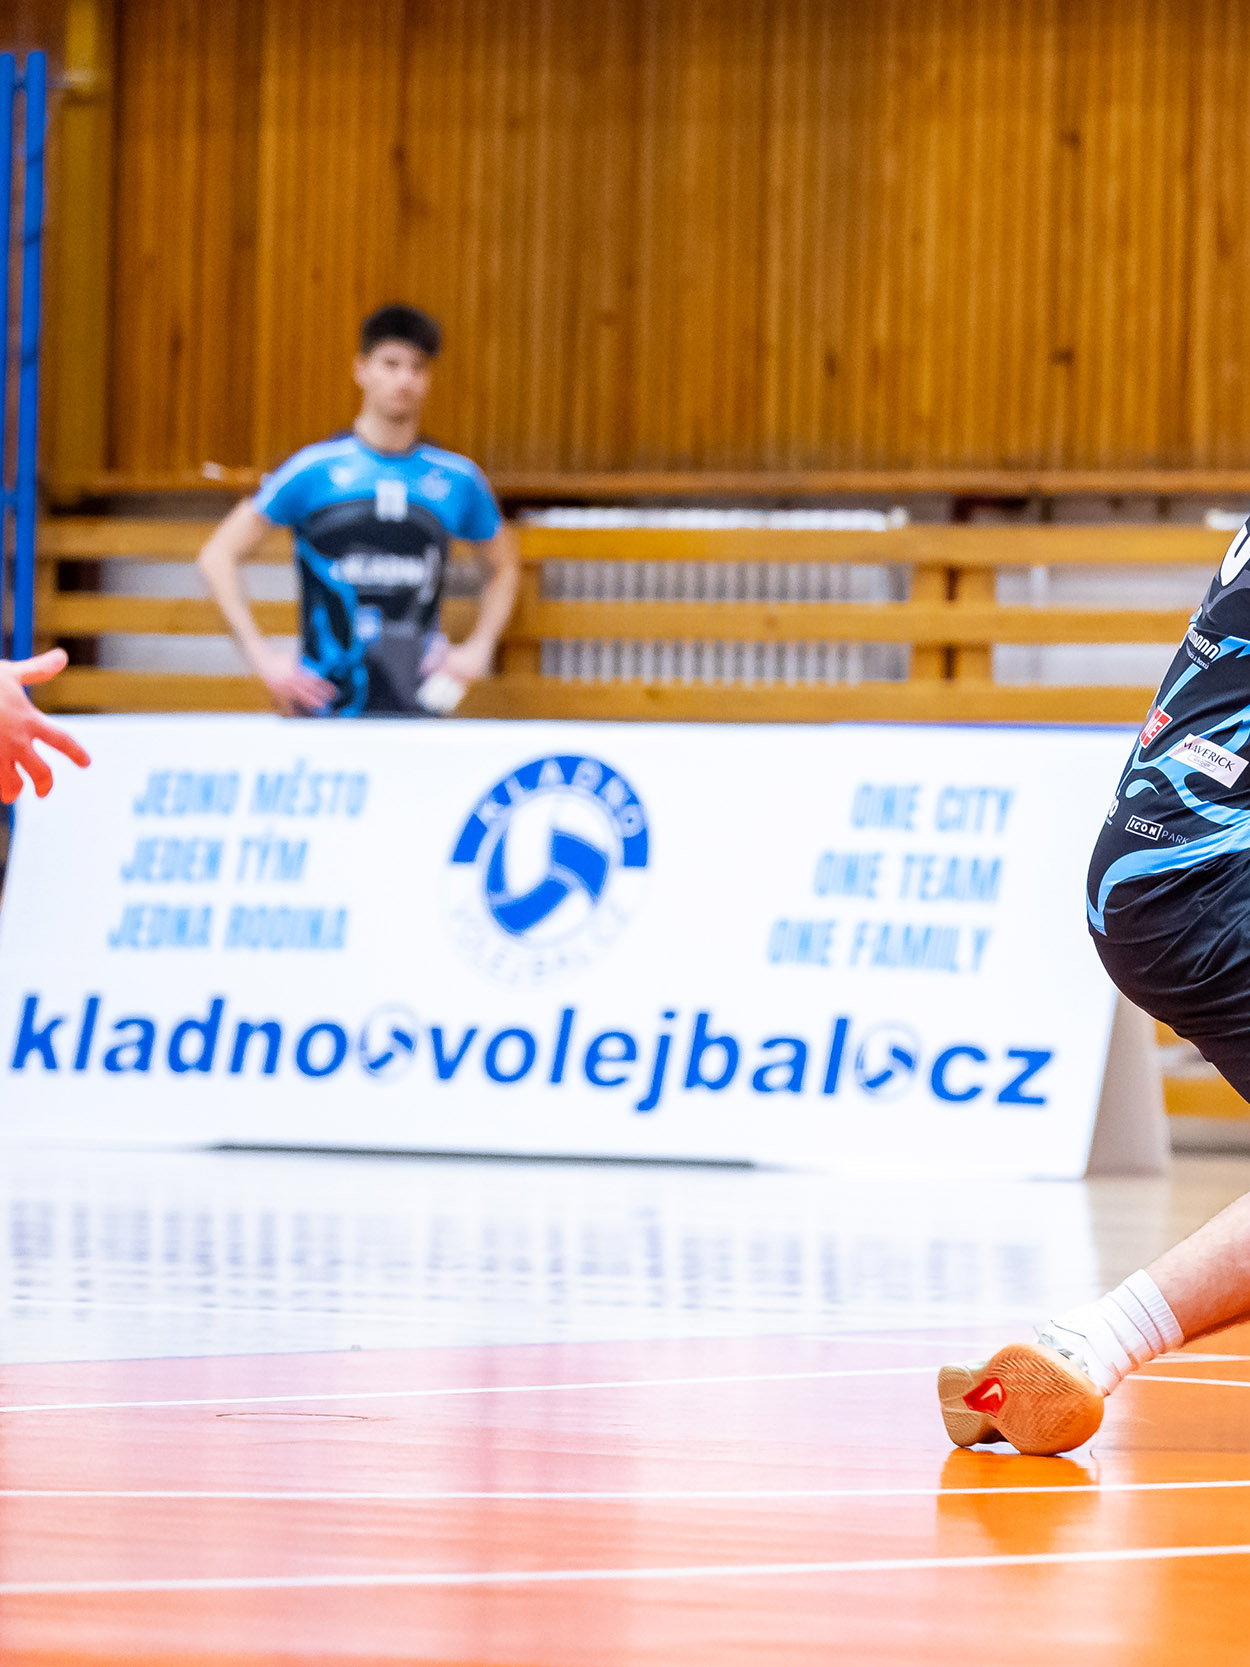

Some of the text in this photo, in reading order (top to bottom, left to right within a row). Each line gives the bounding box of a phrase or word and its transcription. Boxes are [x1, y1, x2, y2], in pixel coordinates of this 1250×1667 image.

[1183, 741, 1236, 772] MAVERICK
[133, 757, 369, 816] JEDNO MĚSTO
[476, 758, 646, 838] KLADNO
[850, 782, 1018, 833] ONE CITY
[120, 824, 309, 882] JEDEN TÝM
[1129, 818, 1190, 845] ICON PARK
[812, 848, 1003, 903] ONE TEAM
[107, 902, 213, 949] JEDNA
[766, 914, 992, 973] ONE FAMILY
[11, 993, 1054, 1112] kladno volejbal cz
